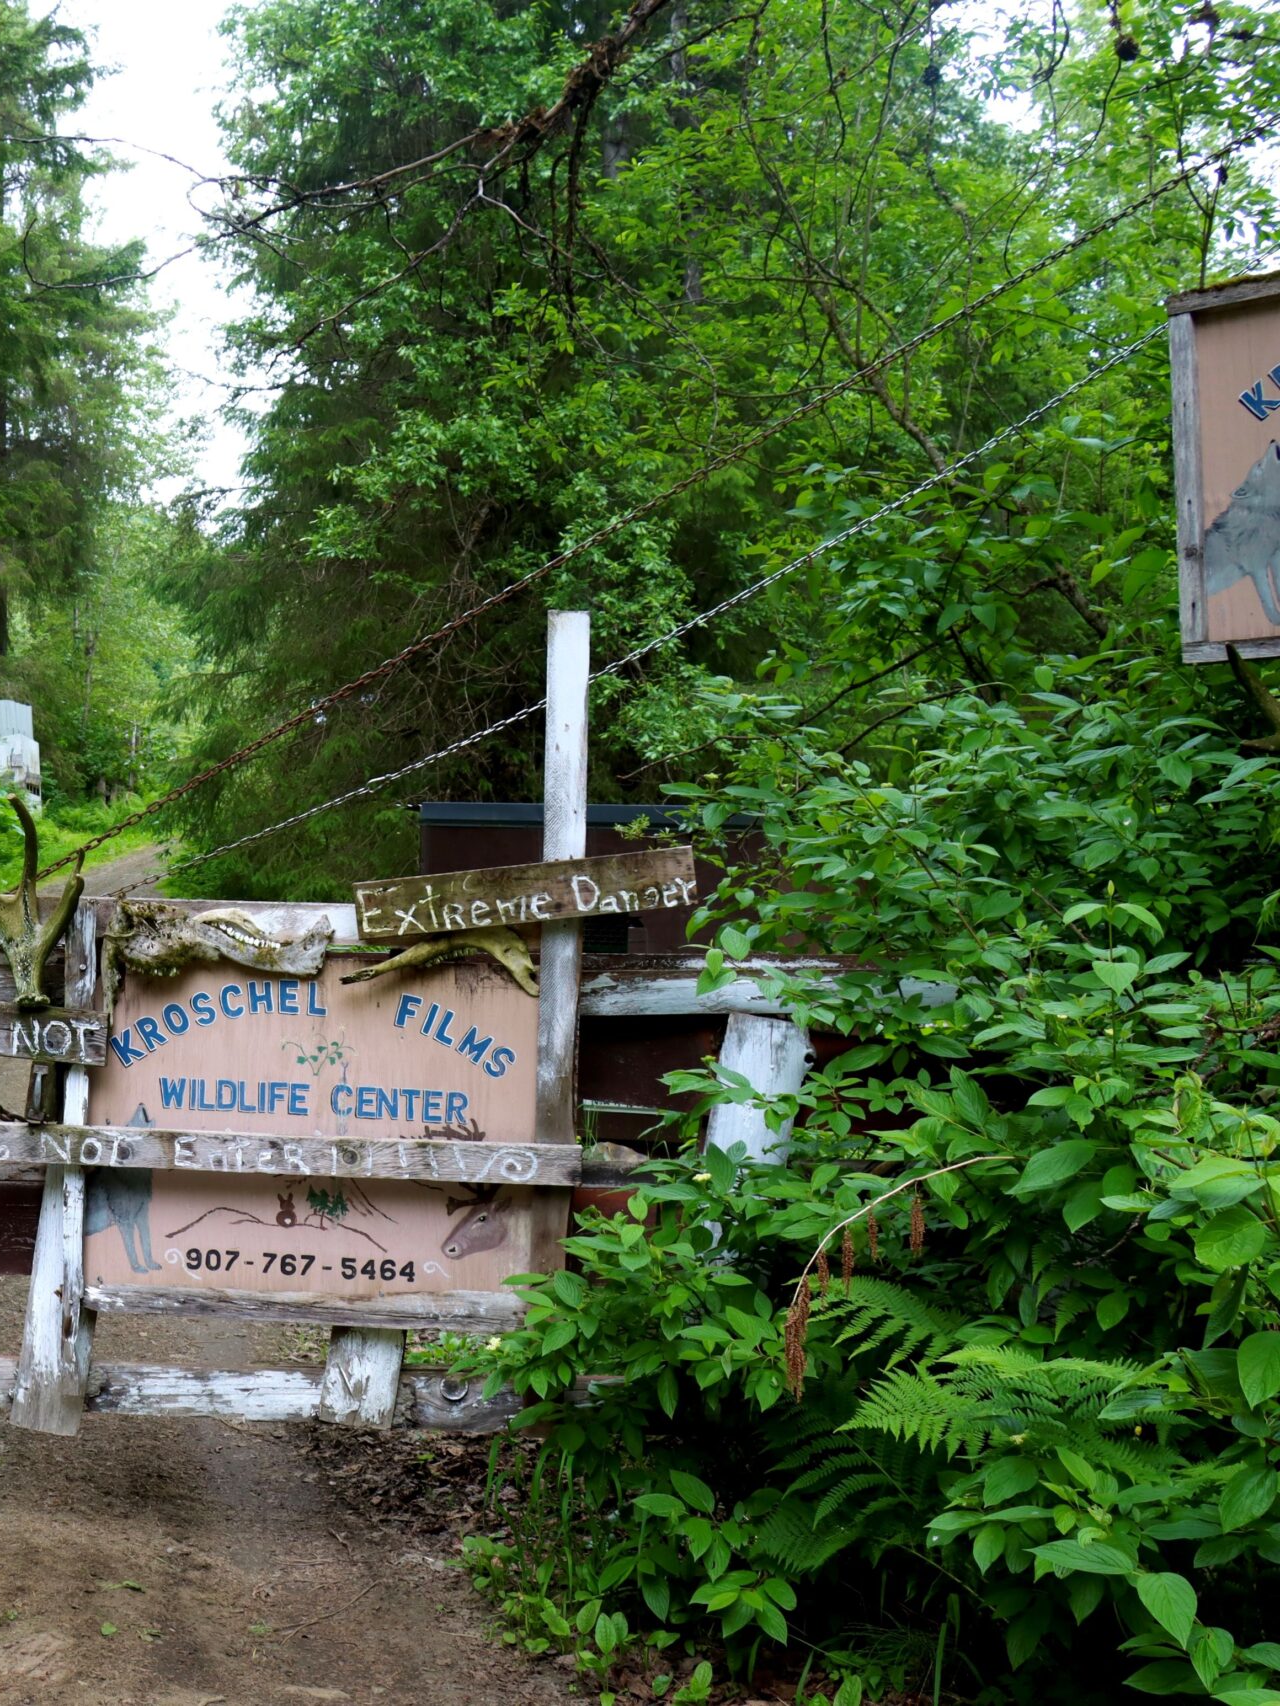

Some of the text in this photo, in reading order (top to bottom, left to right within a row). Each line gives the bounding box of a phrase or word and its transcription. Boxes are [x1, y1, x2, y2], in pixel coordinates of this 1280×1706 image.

[12, 1017, 102, 1062] NOT
[109, 979, 517, 1078] KROSCHEL FILMS
[159, 1076, 470, 1125] WILDLIFE CENTER
[40, 1131, 144, 1167] NOT
